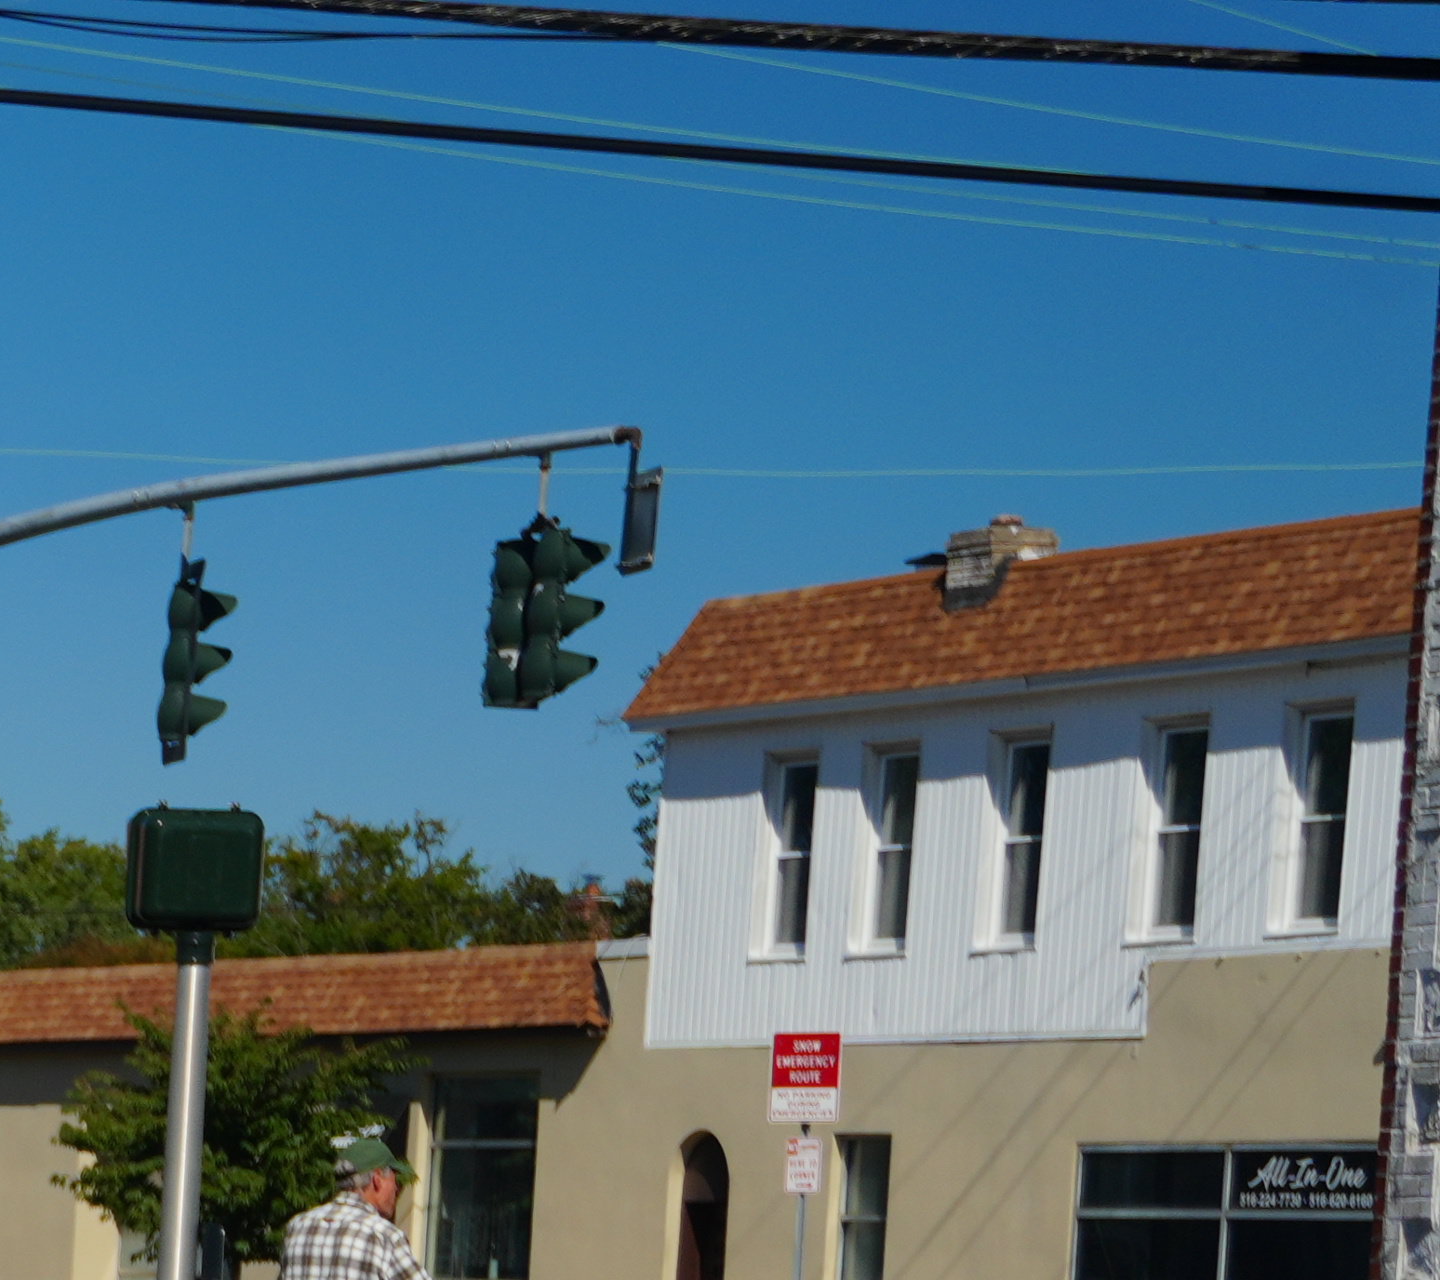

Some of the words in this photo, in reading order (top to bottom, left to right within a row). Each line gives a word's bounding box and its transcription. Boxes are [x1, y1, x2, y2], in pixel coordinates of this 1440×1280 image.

[793, 1040, 822, 1053] SNOW
[777, 1055, 836, 1069] EMERGENCY
[789, 1070, 821, 1084] ROUTE
[1247, 1155, 1368, 1192] All-In-One
